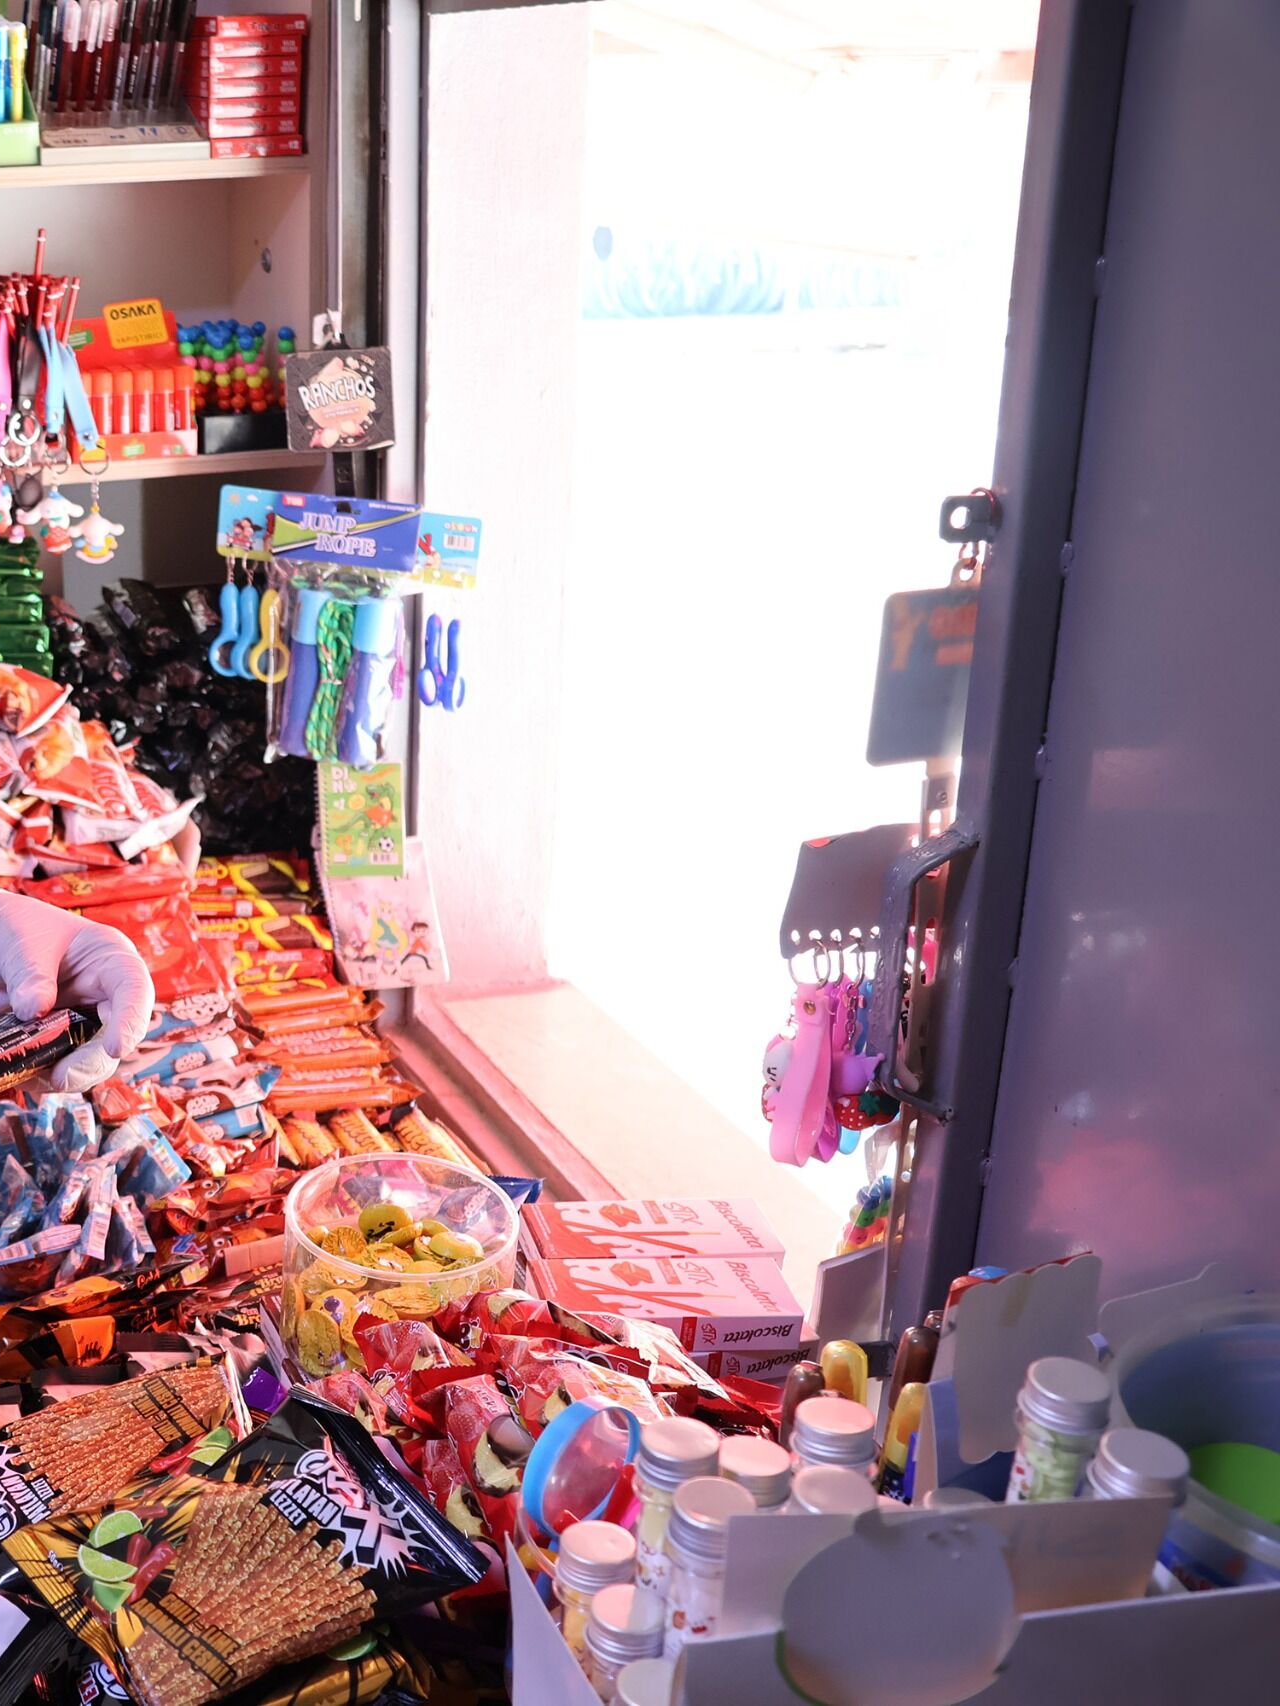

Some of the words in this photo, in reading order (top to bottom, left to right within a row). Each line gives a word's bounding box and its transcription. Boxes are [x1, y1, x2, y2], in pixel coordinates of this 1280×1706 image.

[109, 304, 157, 321] OSAKA
[297, 375, 377, 412] RANCHOS
[299, 511, 358, 534] JUMP
[314, 533, 377, 558] ROPE
[663, 1201, 703, 1226] STIX
[709, 1199, 764, 1249] Biscolata
[677, 1261, 718, 1288] STIX
[724, 1260, 781, 1313] Biscolata
[701, 1323, 717, 1346] STIX
[723, 1323, 794, 1343] Biscolata
[746, 1348, 810, 1374] Biscolata
[0, 1475, 52, 1525] PATLAYAN
[30, 1478, 55, 1502] LEZZET
[269, 1488, 308, 1527] LEZZET
